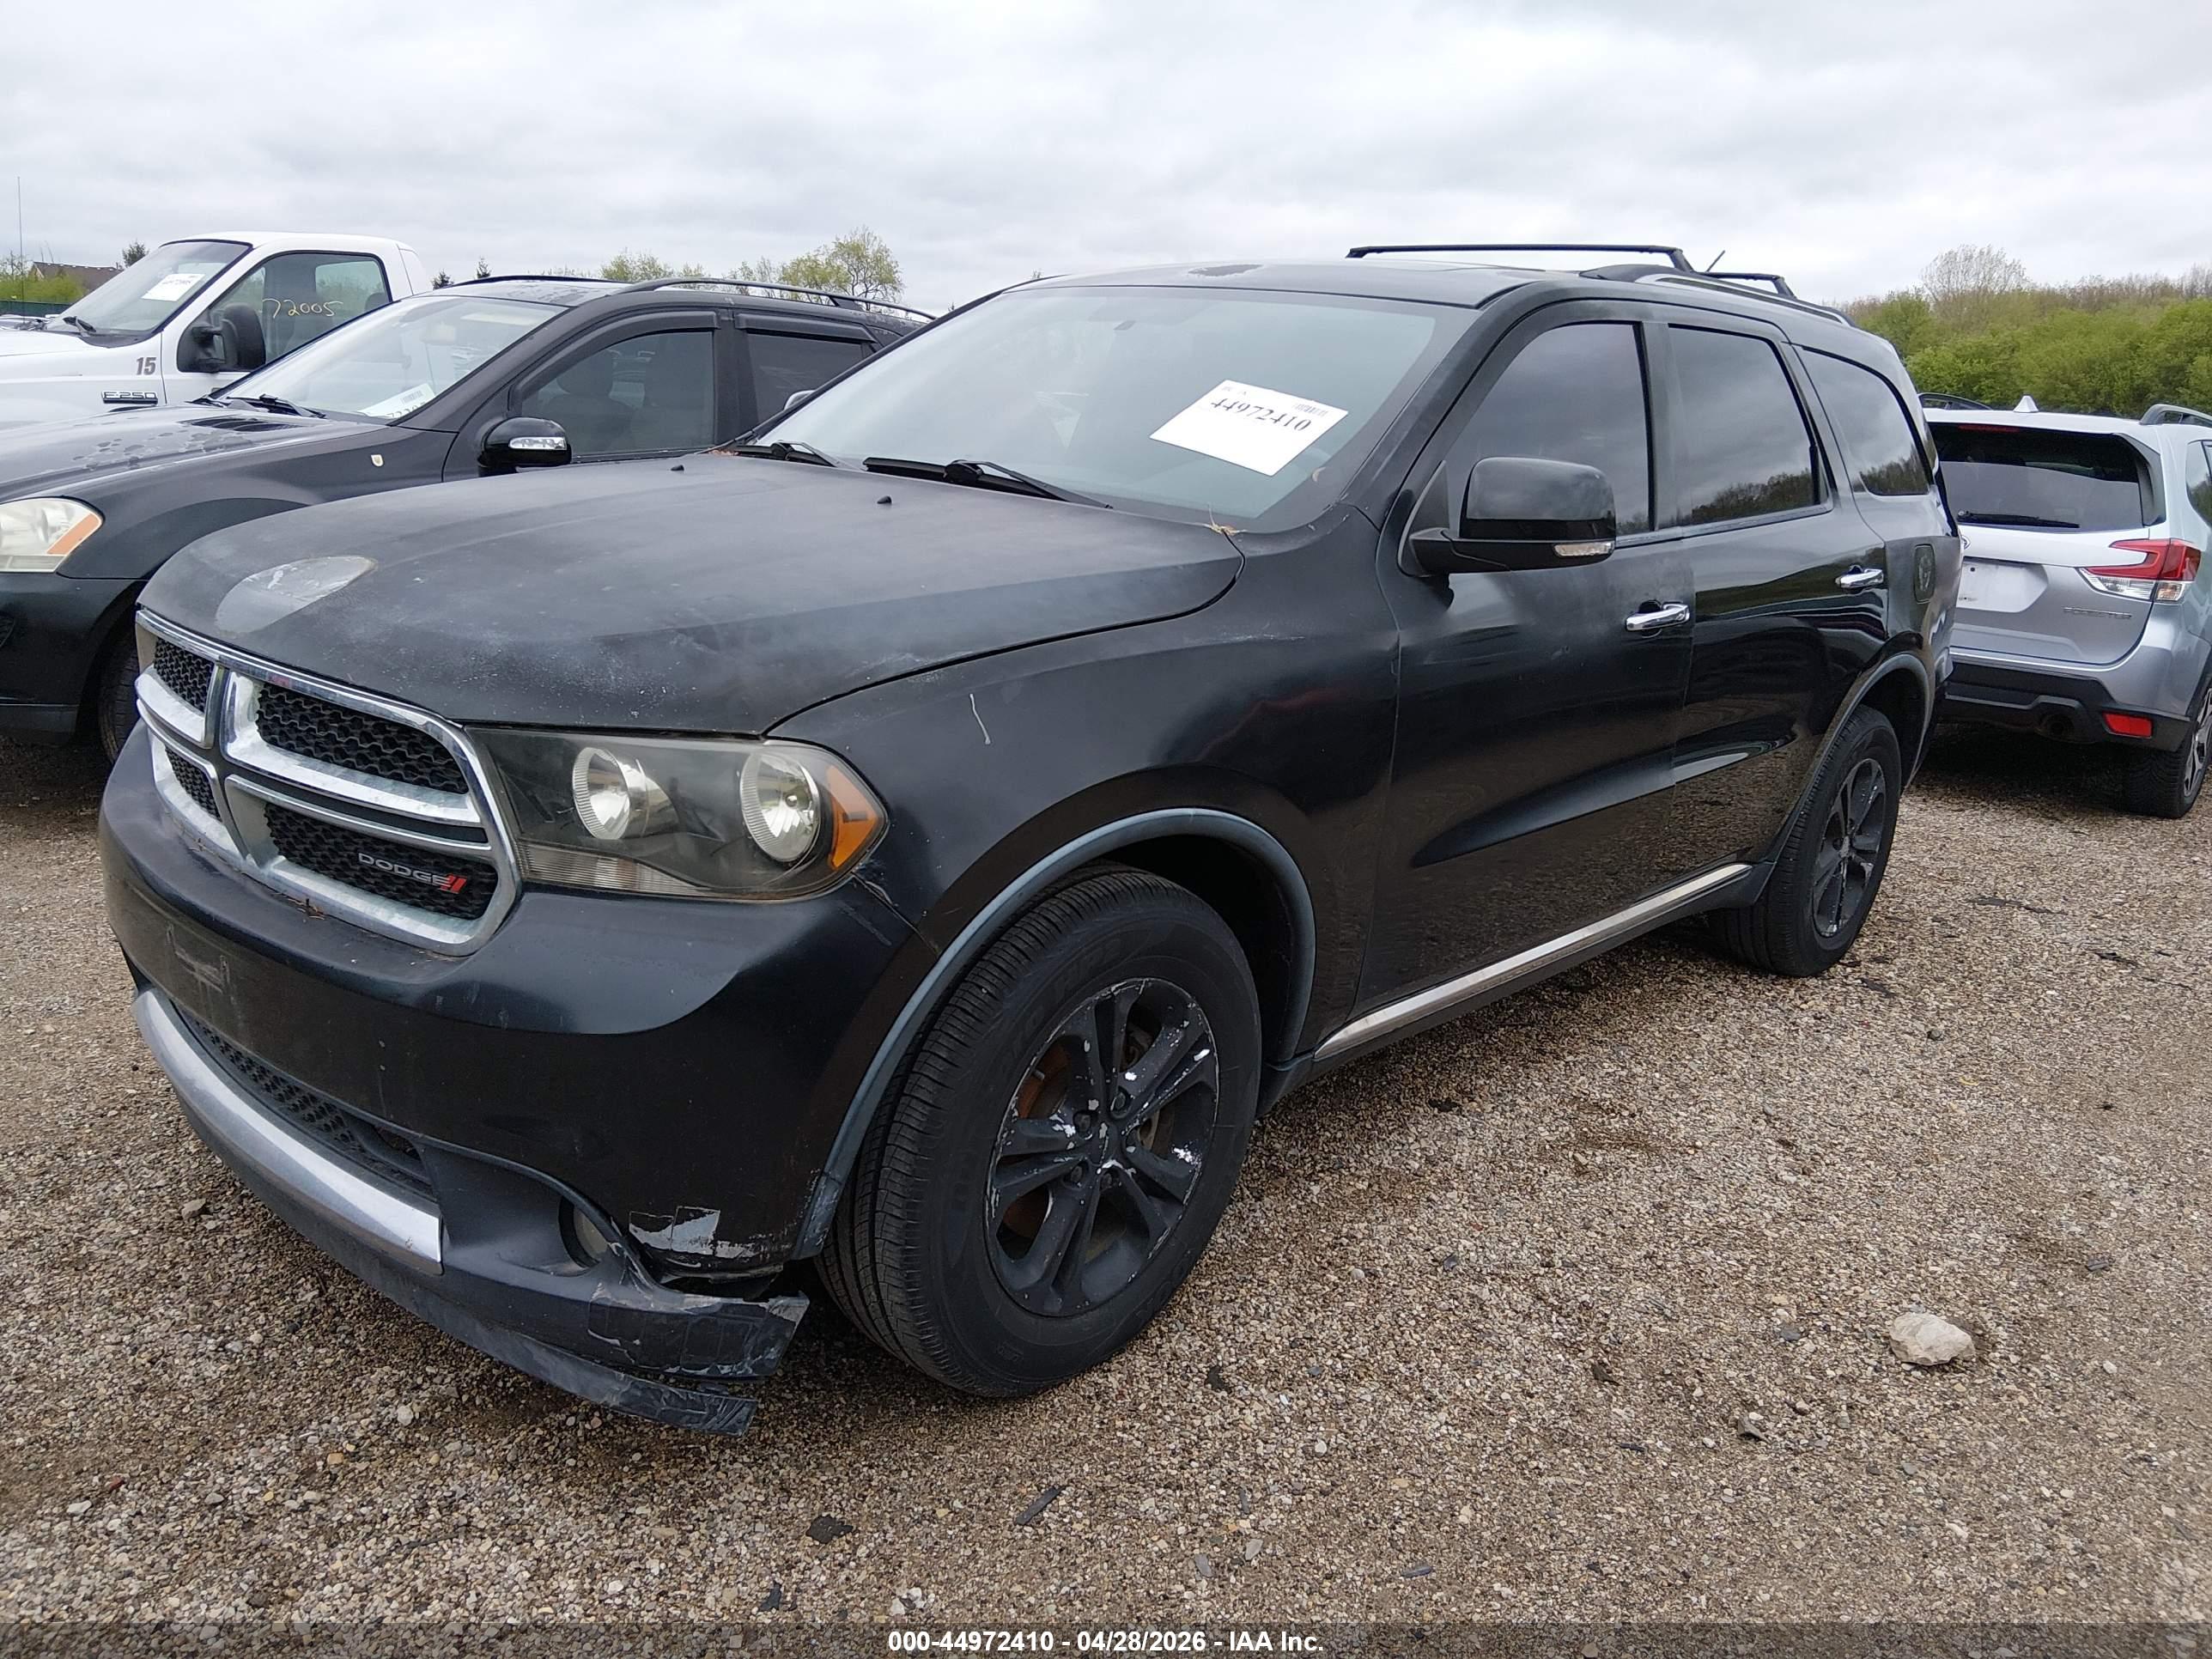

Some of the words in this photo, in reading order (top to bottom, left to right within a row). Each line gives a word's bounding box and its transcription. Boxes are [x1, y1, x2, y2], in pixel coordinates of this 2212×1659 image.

[262, 298, 343, 319] 72005
[137, 356, 156, 375] 15
[1211, 398, 1311, 431] 44972410
[358, 853, 452, 888] DODGE
